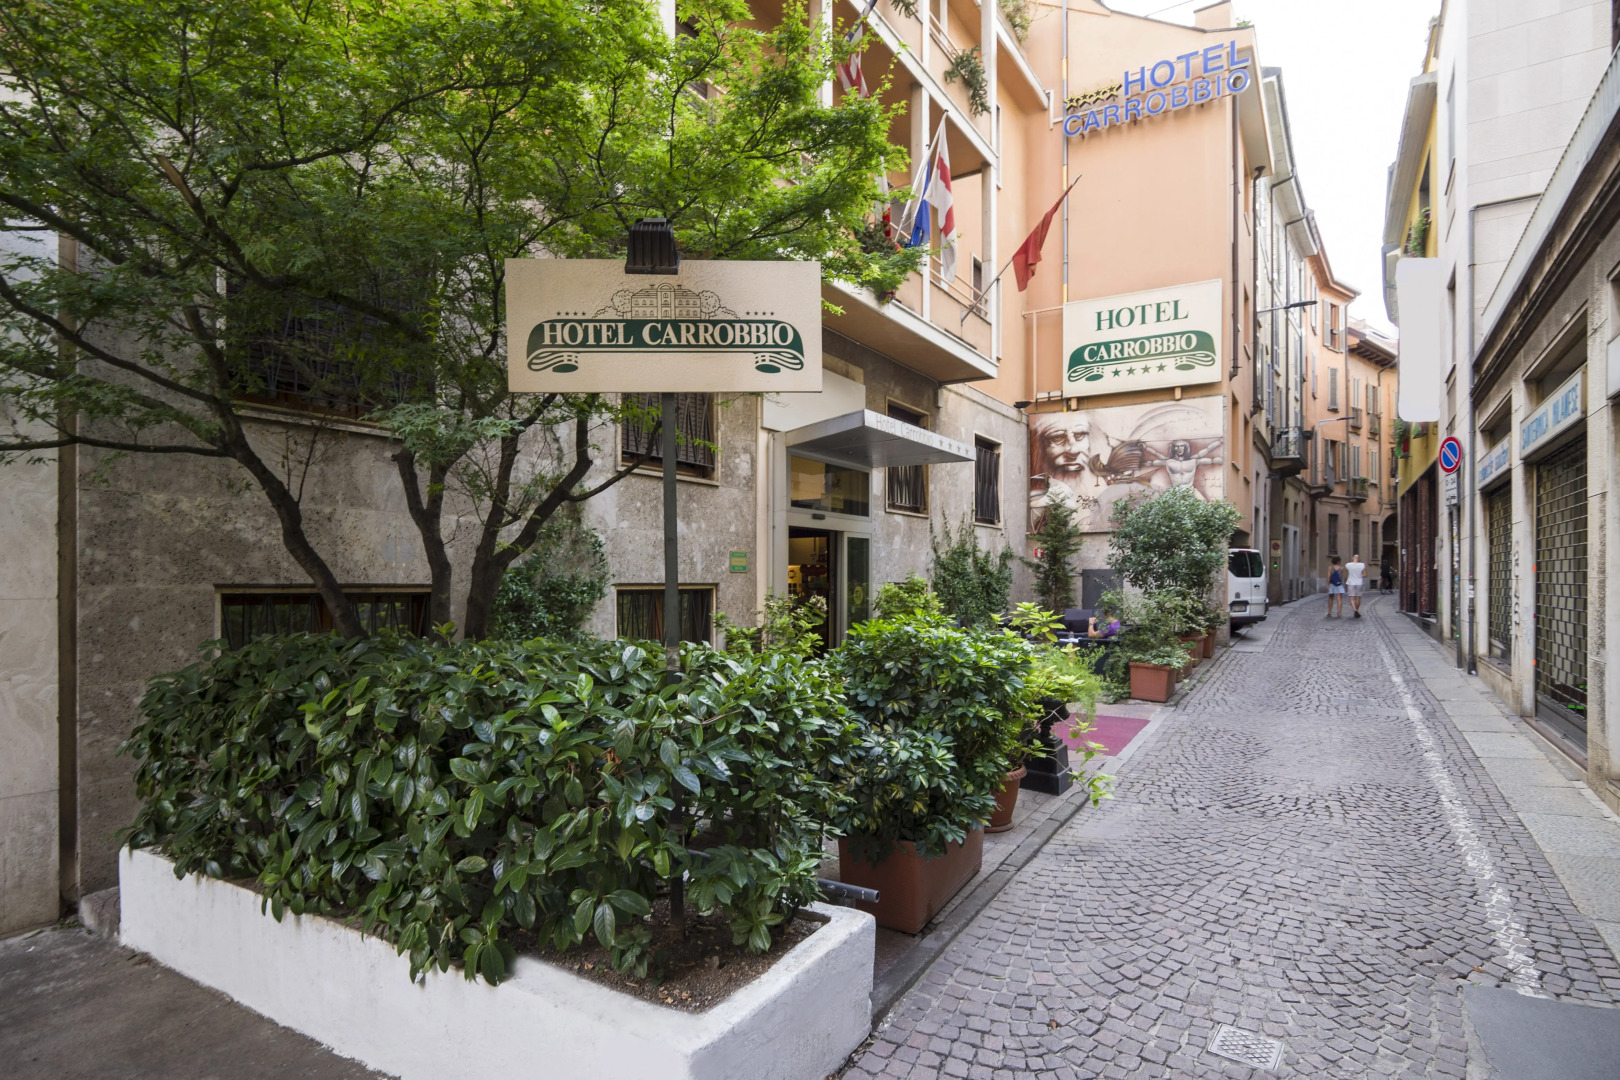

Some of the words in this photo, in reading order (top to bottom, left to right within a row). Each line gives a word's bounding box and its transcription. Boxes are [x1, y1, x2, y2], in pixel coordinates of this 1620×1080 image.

[1124, 39, 1250, 96] HOTEL
[1063, 69, 1251, 137] CARROBBIO
[1094, 299, 1189, 332] HOTEL
[541, 322, 634, 346] HOTEL
[641, 322, 795, 346] CARROBBIO
[1083, 332, 1198, 363] CARROBBIO
[876, 413, 896, 434] Hotel
